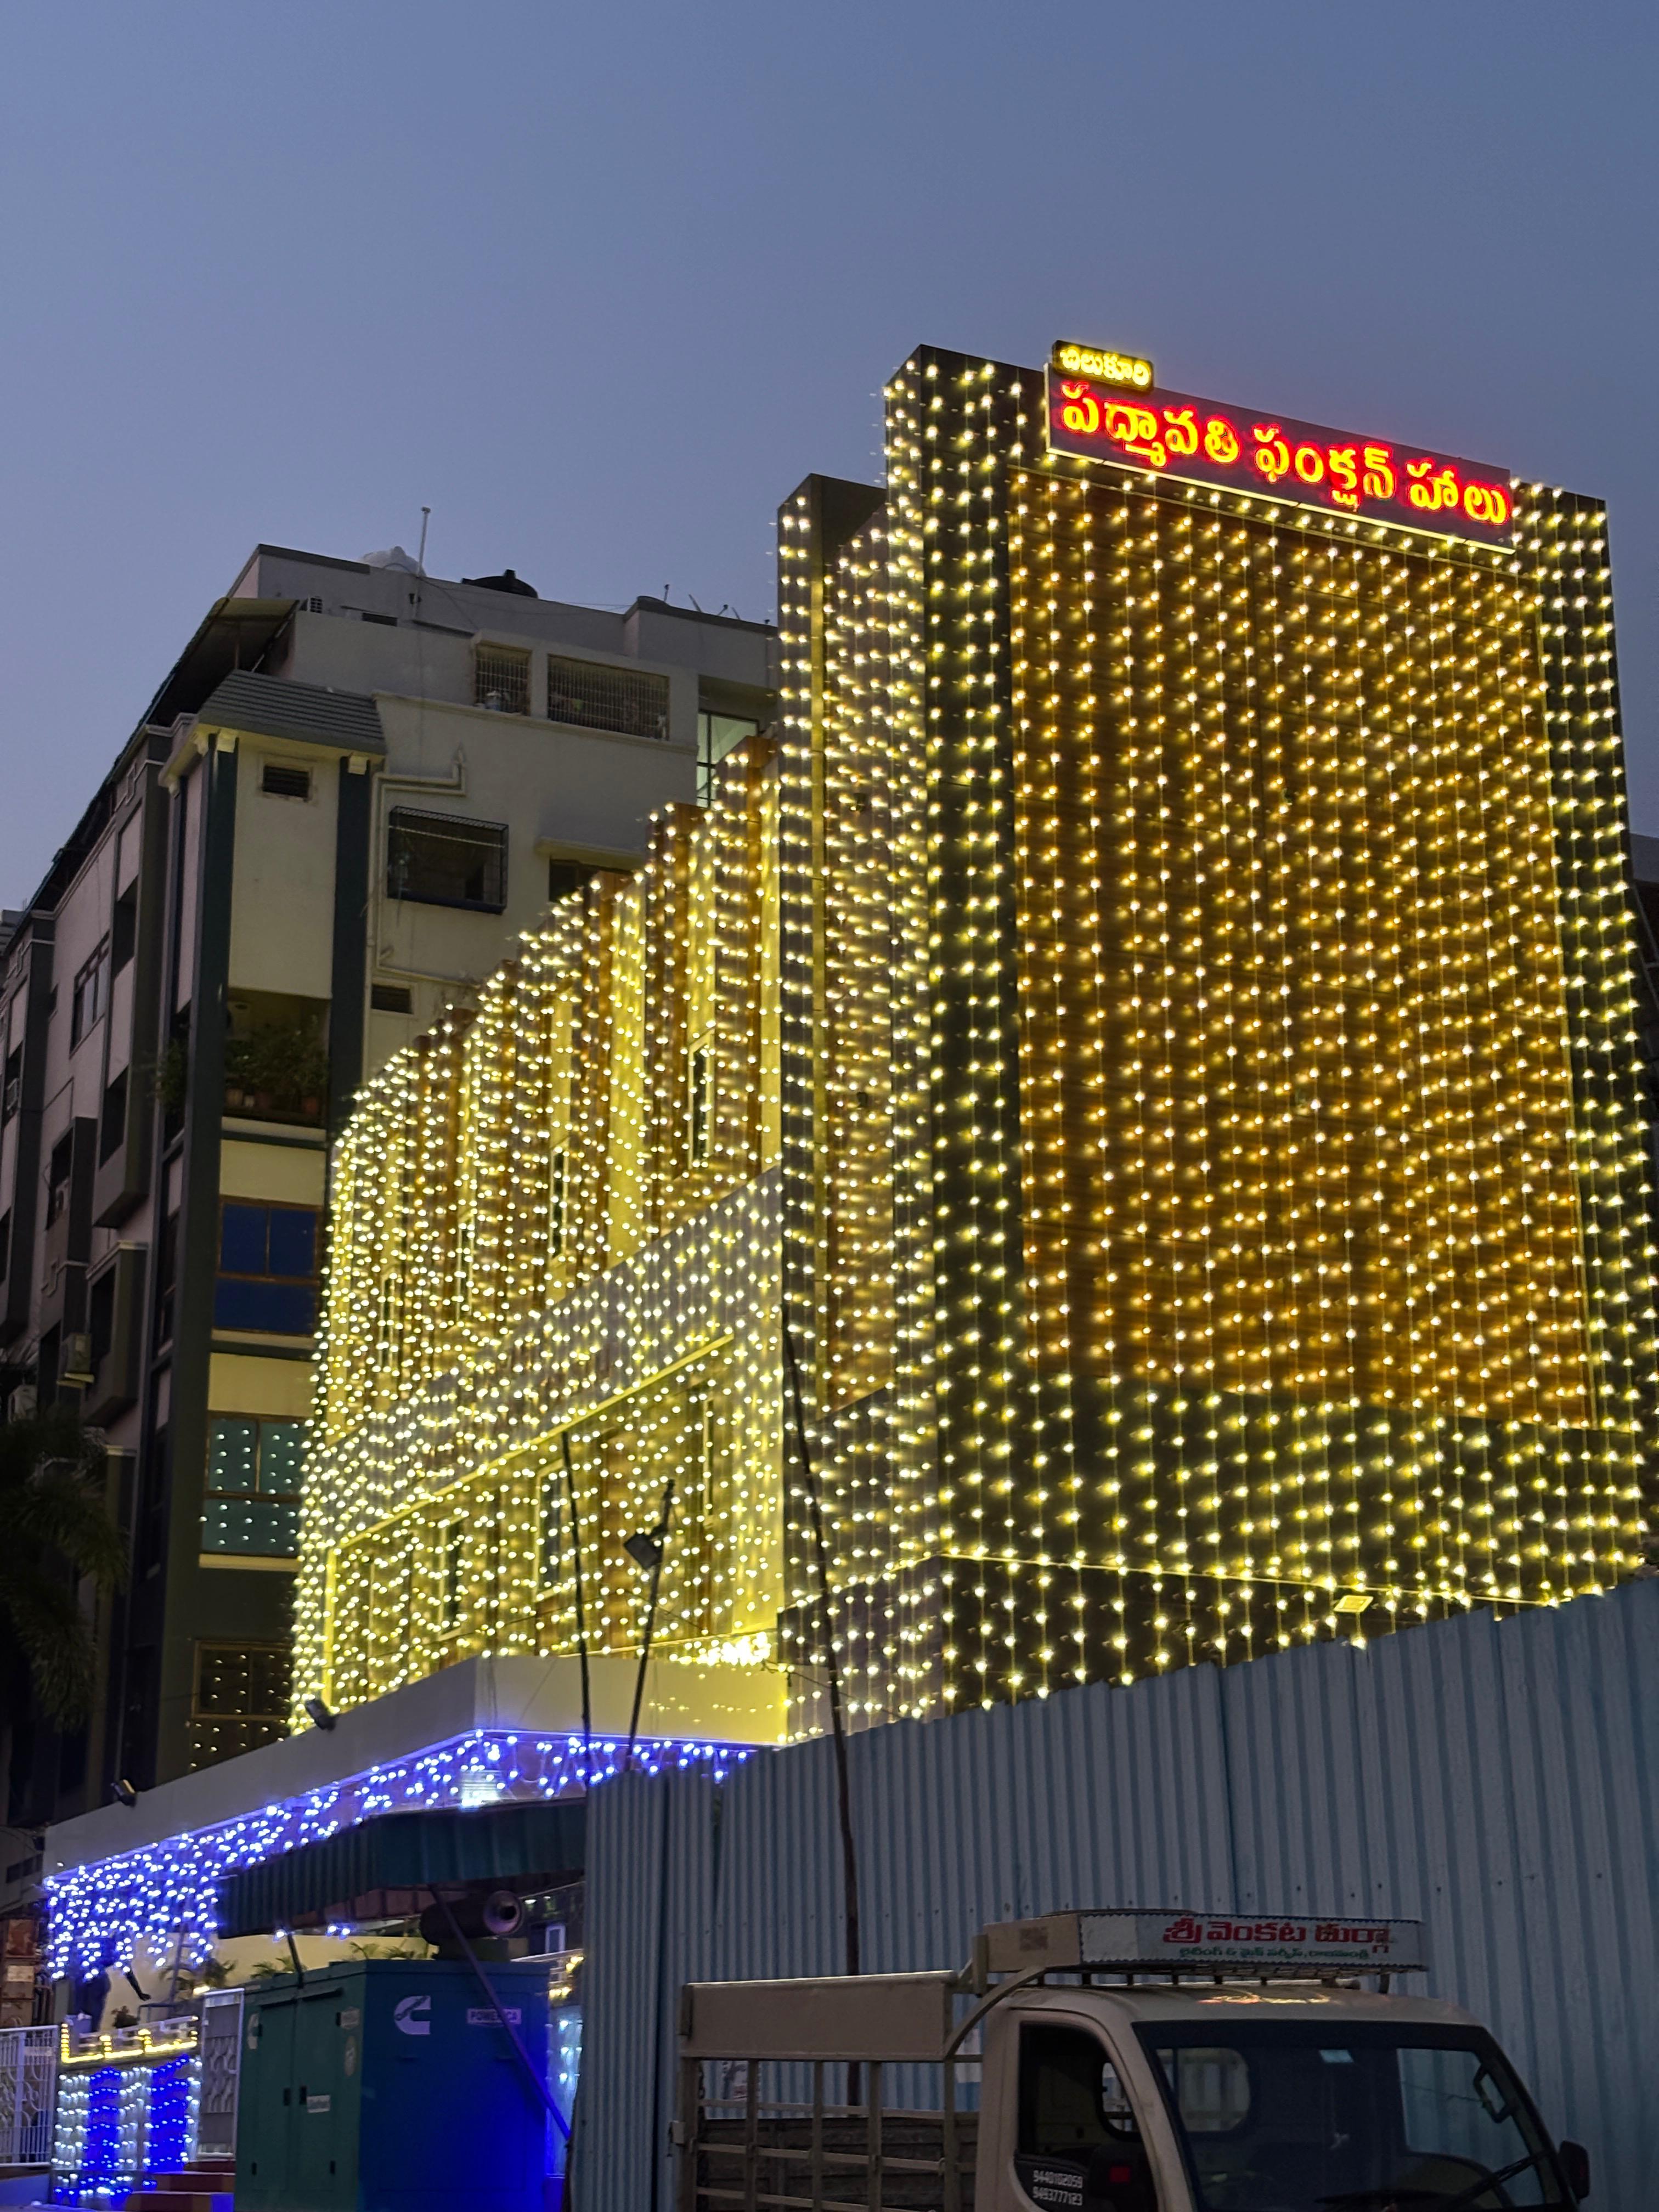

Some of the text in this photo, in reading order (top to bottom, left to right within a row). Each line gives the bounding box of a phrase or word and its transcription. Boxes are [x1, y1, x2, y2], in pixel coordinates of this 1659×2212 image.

[1061, 381, 1508, 524] పద్మావతి ఫంక్షన్ హాలు
[1163, 1917, 1203, 1944] శ్రీ
[1207, 1921, 1306, 1942] వెంకట
